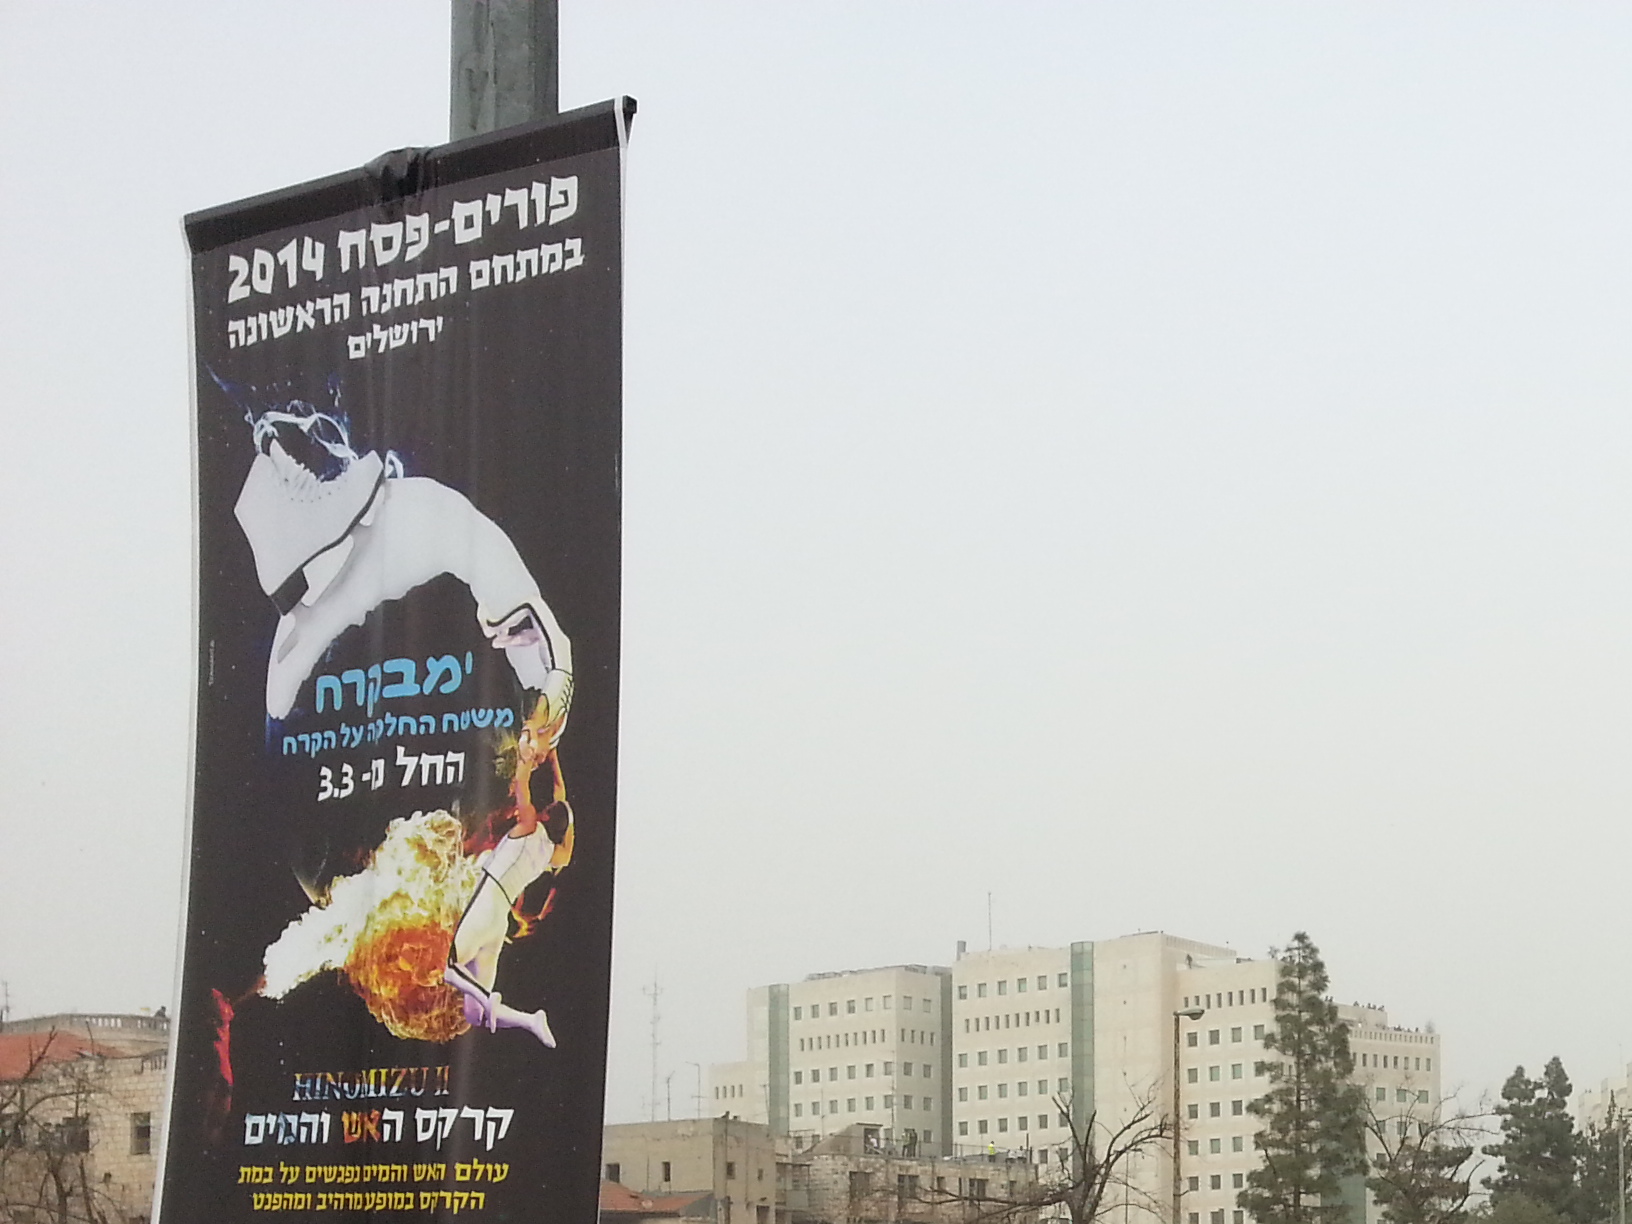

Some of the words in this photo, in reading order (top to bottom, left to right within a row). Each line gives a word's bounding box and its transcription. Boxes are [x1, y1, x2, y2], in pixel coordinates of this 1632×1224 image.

[338, 175, 579, 273] פורים-פסח
[227, 236, 326, 304] 2014
[469, 237, 585, 291] במתחם
[360, 265, 458, 317] התחנה
[228, 291, 351, 350] הראשונה
[347, 315, 444, 360] ירושלים
[340, 723, 364, 749] על
[442, 707, 515, 733] משטח
[282, 728, 337, 759] הקרח
[395, 745, 465, 787] החל
[244, 1108, 332, 1146] והמים
[340, 1107, 405, 1144] האש
[414, 1105, 515, 1151] קרקס
[237, 1165, 274, 1185] במת
[279, 1160, 300, 1184] על
[413, 1163, 446, 1182] האש
[455, 1157, 510, 1183] עולם
[252, 1191, 313, 1211] ומהפנט
[365, 1191, 415, 1211] במופע
[419, 1190, 486, 1215] הקרקס
